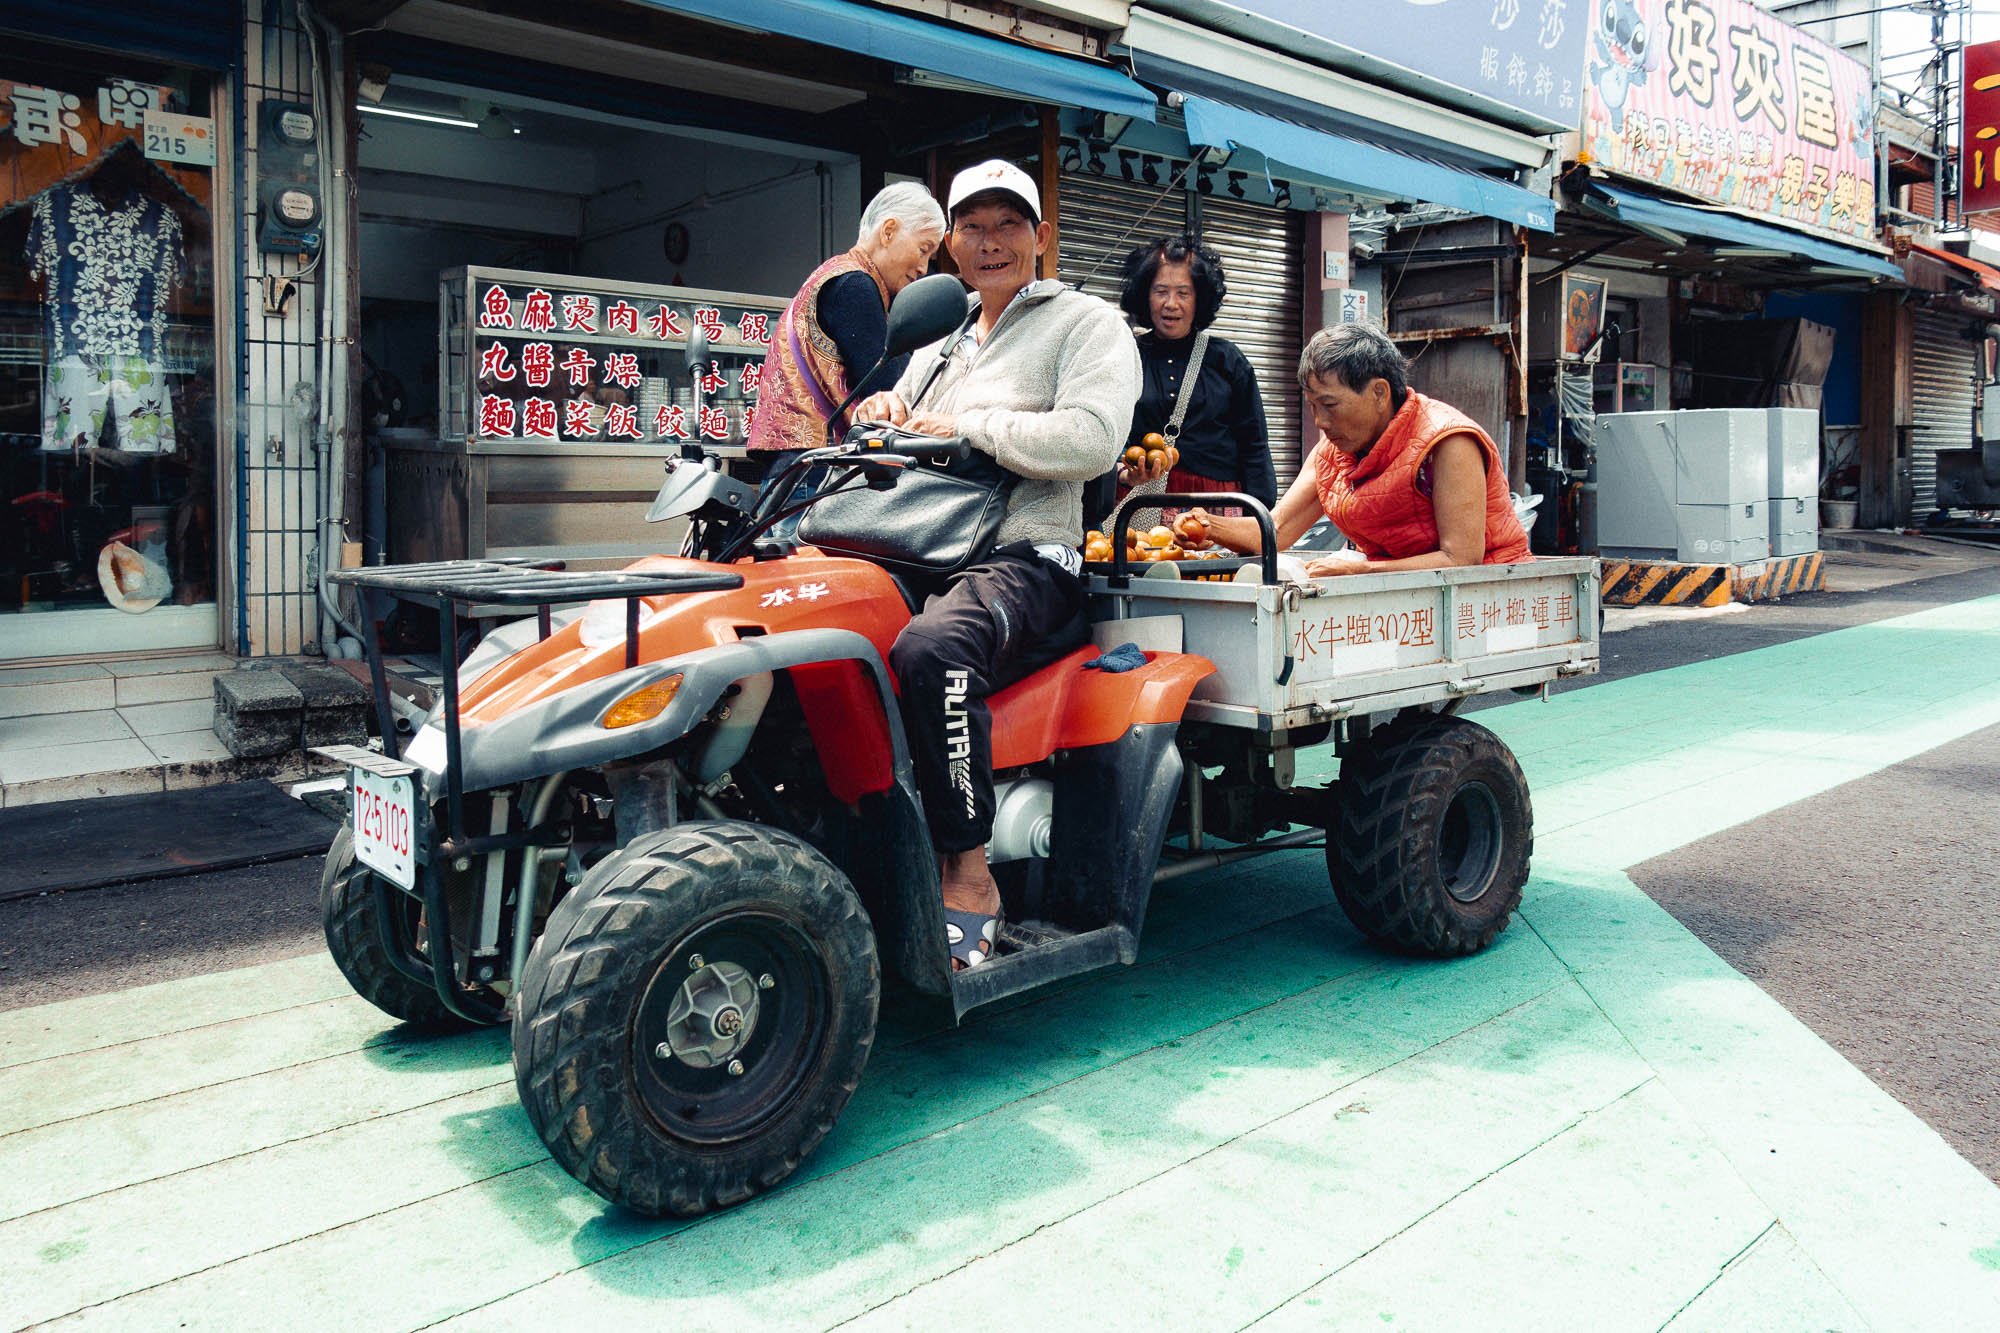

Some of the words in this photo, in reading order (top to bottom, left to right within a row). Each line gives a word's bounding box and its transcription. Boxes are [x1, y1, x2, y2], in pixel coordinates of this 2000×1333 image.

[1667, 0, 1838, 149] 好夾屋
[148, 134, 186, 156] 215
[1779, 153, 1873, 227] 親子樂園
[480, 285, 516, 438] 魚丸麵
[521, 289, 556, 438] 麻醬麵
[561, 295, 597, 438] 燙青菜
[604, 301, 643, 439] 肉燥飯
[649, 304, 690, 439] 水餃
[759, 582, 830, 608] 水牛
[1294, 606, 1435, 661] 水牛牌302型
[1457, 592, 1574, 640] 農地搬運車
[356, 785, 408, 857] T2-5103
